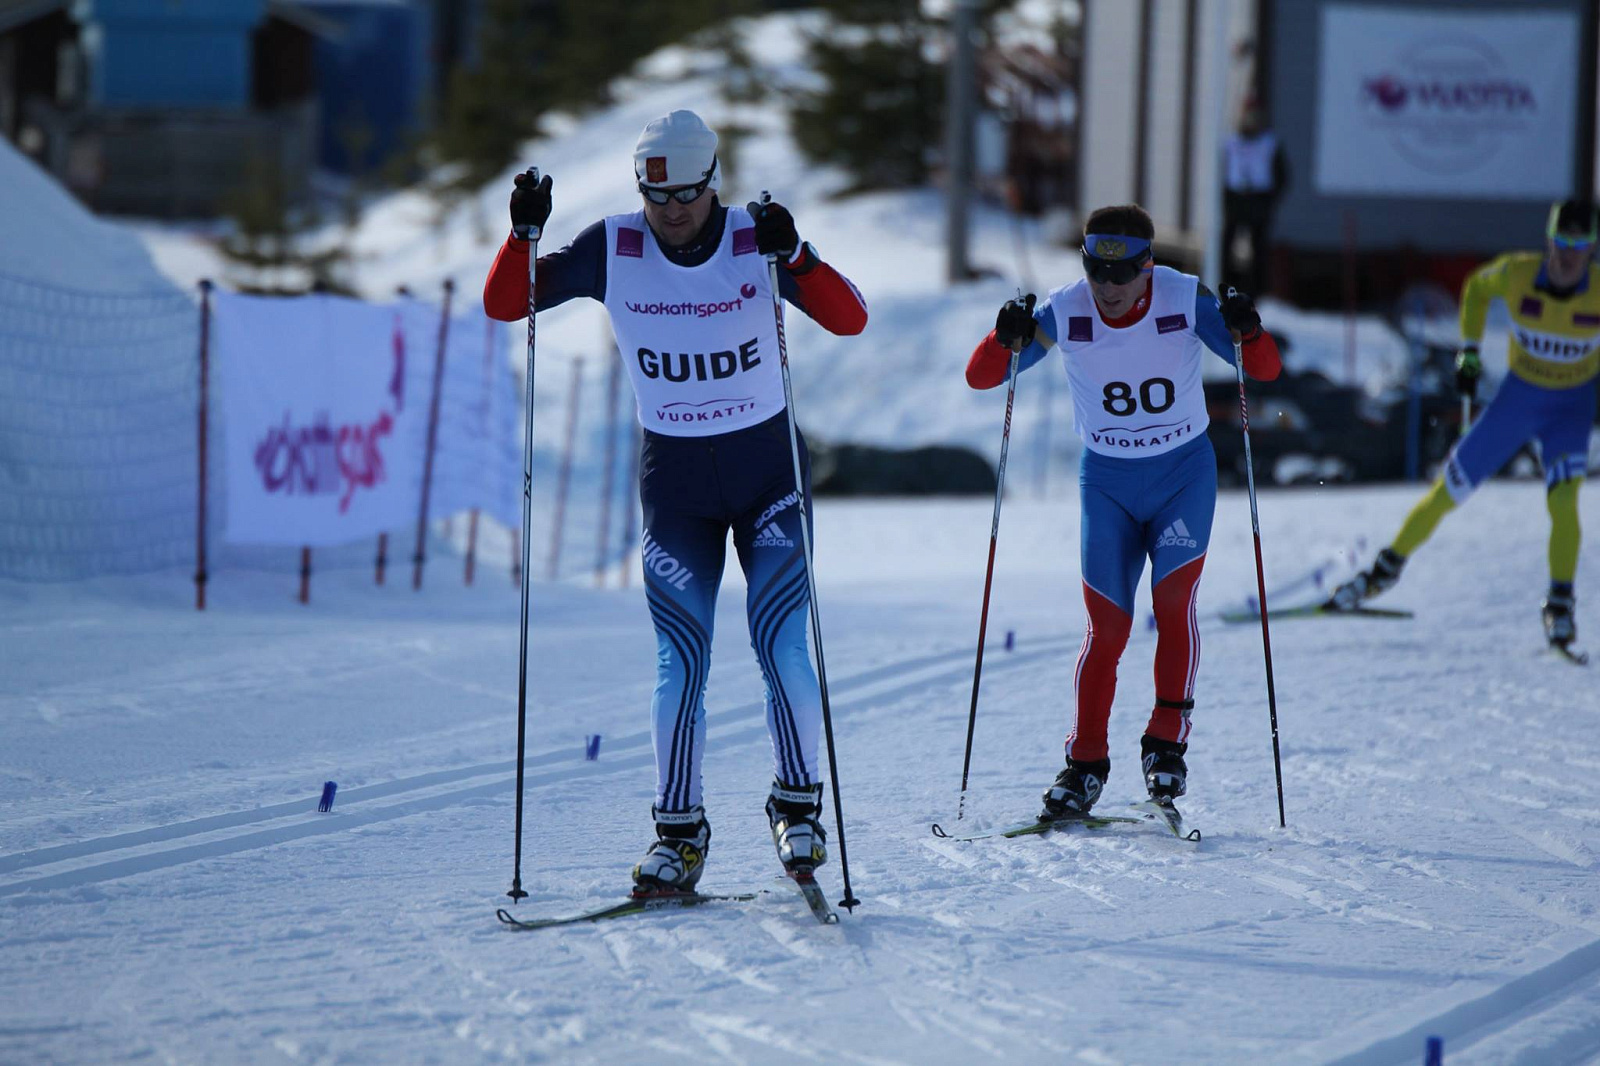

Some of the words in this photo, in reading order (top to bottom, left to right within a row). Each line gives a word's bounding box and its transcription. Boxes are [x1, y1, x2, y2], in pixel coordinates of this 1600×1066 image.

[625, 298, 743, 318] vuokattisport
[637, 336, 762, 383] GUIDE
[1102, 377, 1175, 417] 80
[656, 402, 754, 422] VUOKATTI
[1090, 424, 1191, 448] VUOKATTI
[752, 537, 794, 548] adidas
